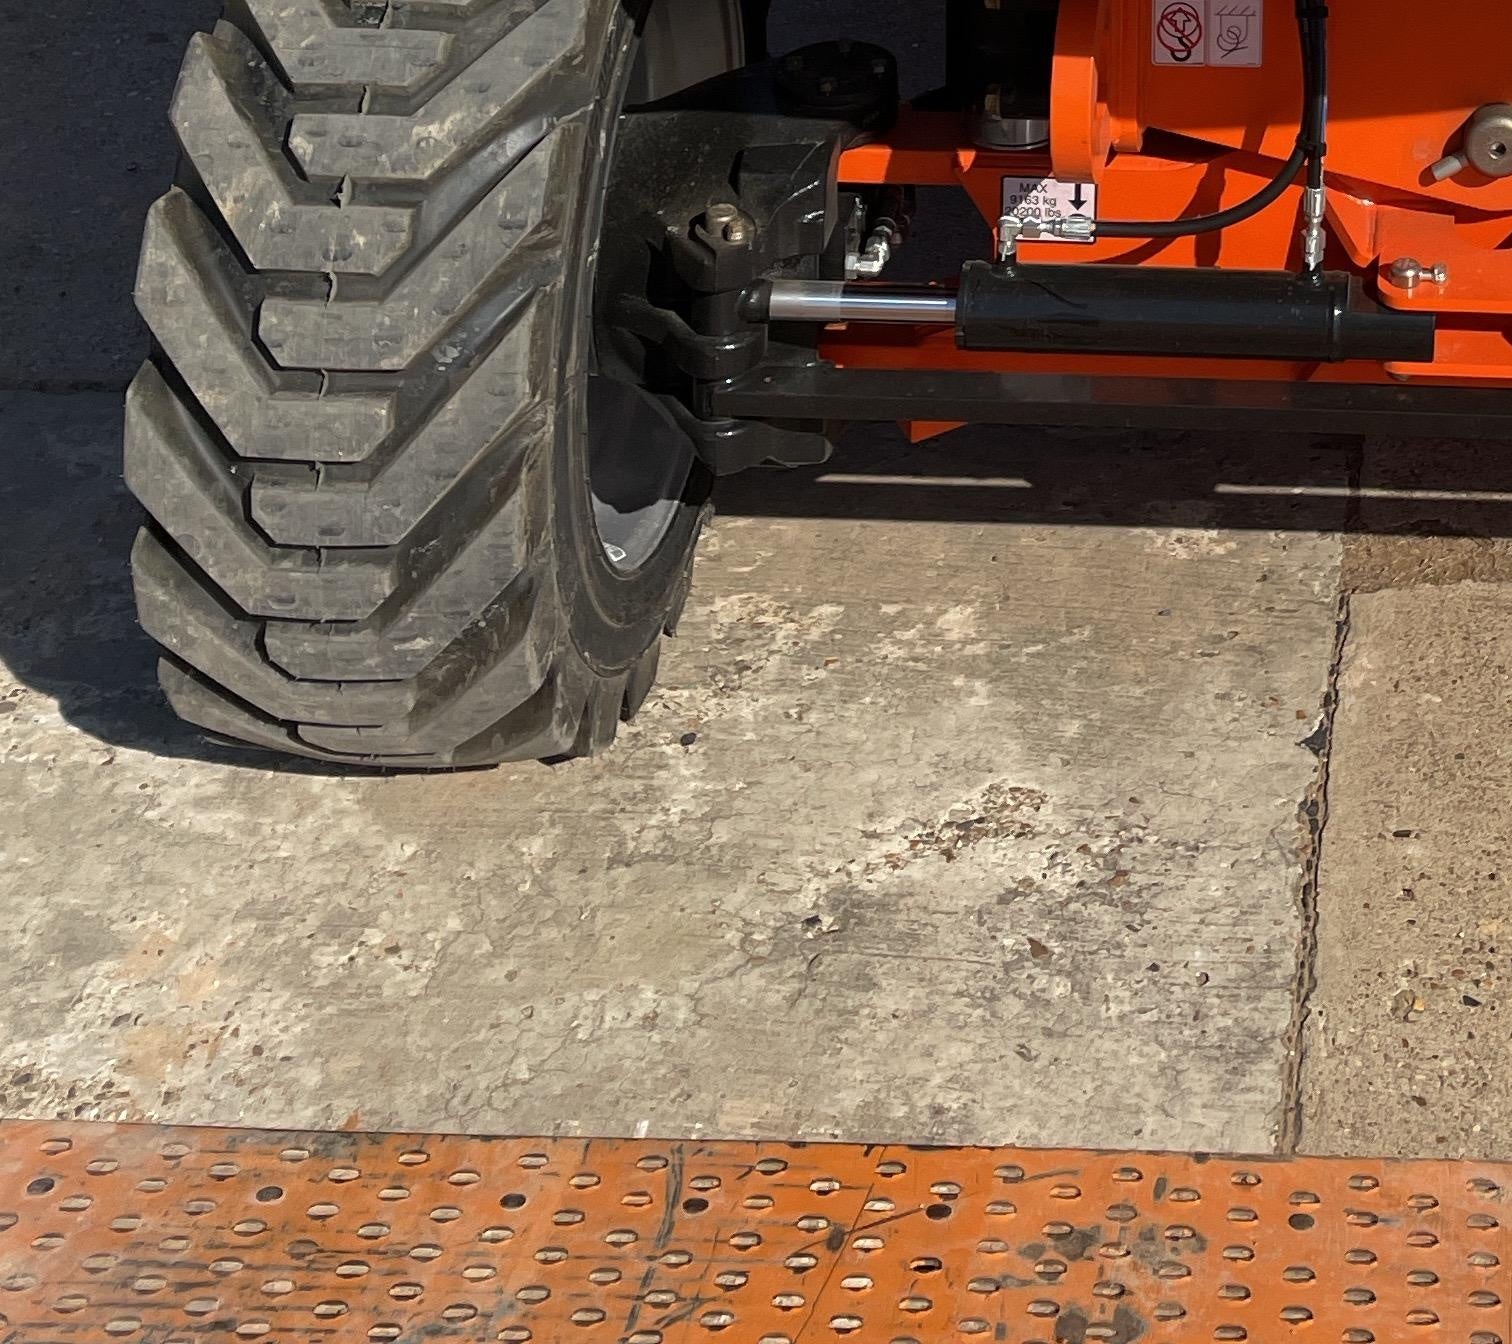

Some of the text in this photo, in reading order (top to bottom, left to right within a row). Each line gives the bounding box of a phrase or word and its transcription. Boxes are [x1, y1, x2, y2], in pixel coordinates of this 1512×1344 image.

[1020, 182, 1048, 194] MAX
[1009, 194, 1056, 207] 9163 kg
[1005, 206, 1061, 218] 20200 lbs
